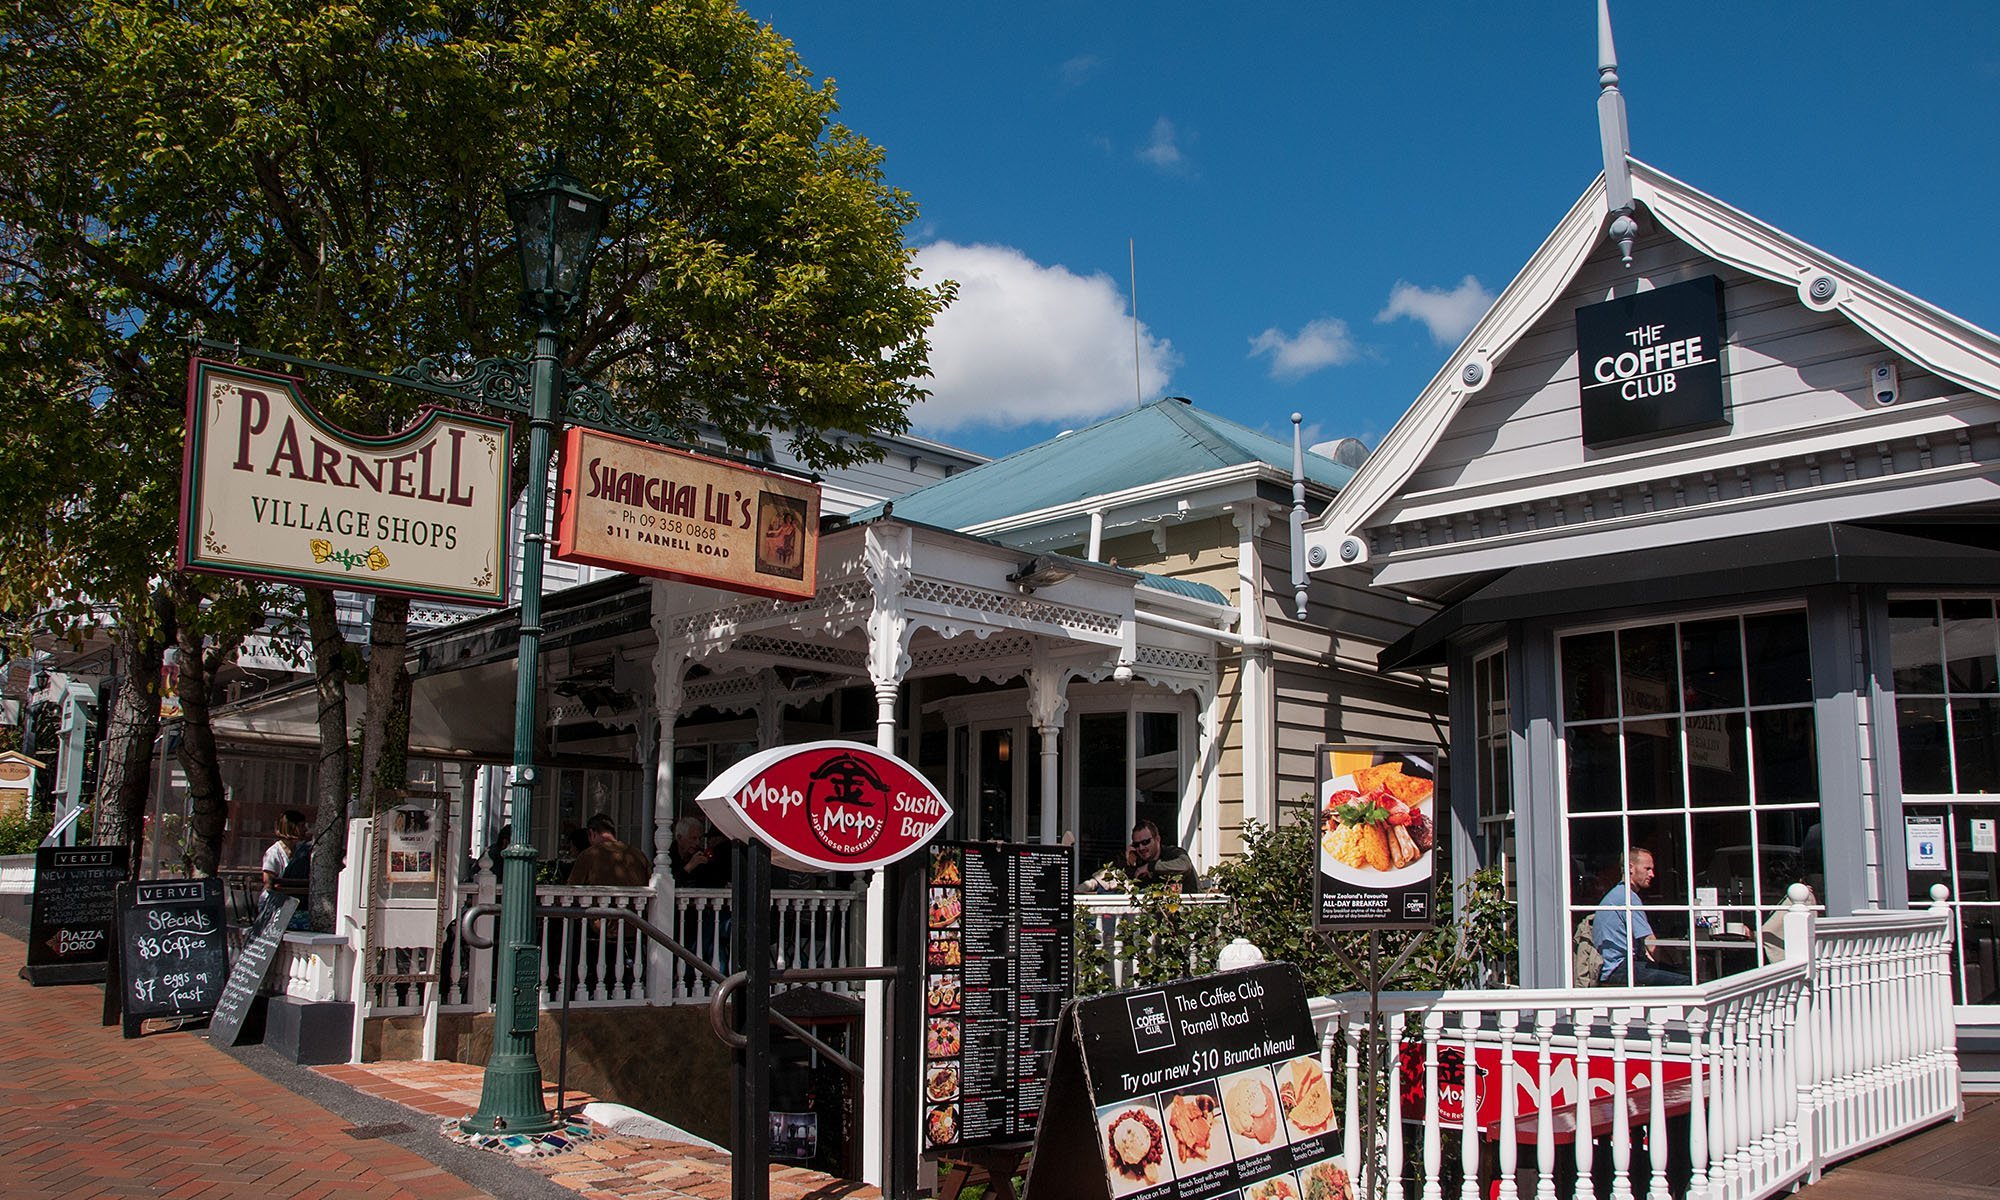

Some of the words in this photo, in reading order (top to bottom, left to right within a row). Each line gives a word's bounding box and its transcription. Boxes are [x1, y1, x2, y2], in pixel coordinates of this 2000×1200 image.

[1625, 324, 1665, 347] THE
[1594, 336, 1703, 382] COFFEE
[1621, 373, 1677, 401] CLUB
[233, 387, 474, 507] PARNELL
[587, 458, 697, 519] SHANGHAI
[704, 483, 751, 530] LIL'S
[251, 495, 370, 538] VILLAGE
[377, 515, 457, 550] SHOPS
[623, 510, 636, 525] Ph
[640, 514, 656, 528] 09
[660, 518, 682, 534] 358
[686, 523, 716, 541] 0868
[607, 525, 630, 540] 311
[638, 531, 691, 552] PARNELL
[697, 543, 730, 558] ROAD
[893, 791, 940, 817] Sushi
[811, 813, 843, 852] Japanese
[843, 819, 884, 853] Restaurant
[900, 816, 934, 838] Bar
[60, 854, 107, 863] VERVE
[143, 887, 198, 899] VERVE
[60, 929, 104, 941] PIAZZA
[60, 940, 96, 953] DORO
[137, 936, 160, 960] $3
[161, 936, 207, 960] Coffee
[135, 978, 156, 1002] $7
[163, 972, 190, 988] eggs
[196, 972, 208, 984] on
[168, 986, 204, 1008] Toast
[1175, 995, 1197, 1012] The
[1199, 985, 1236, 1008] Coffee
[1238, 980, 1265, 1000] Club
[1136, 1012, 1165, 1028] COFFEE
[1145, 1024, 1161, 1035] CLUB
[1180, 1012, 1219, 1036] Parnell
[1220, 1006, 1250, 1027] Road
[1121, 1073, 1140, 1093] Try
[1141, 1069, 1163, 1087] our
[1164, 1062, 1190, 1081] new
[1191, 1048, 1219, 1076] $10
[1223, 1043, 1262, 1067] Brunch
[1263, 1035, 1296, 1059] Menu!
[1236, 1161, 1246, 1172] Egg
[1246, 1156, 1263, 1168] Benedict
[1263, 1154, 1272, 1162] with
[1238, 1168, 1255, 1179] Smoked
[1255, 1164, 1272, 1174] Salmon
[1178, 1179, 1193, 1190] French
[1193, 1175, 1205, 1185] Toast
[1205, 1173, 1214, 1182] with
[1213, 1168, 1230, 1178] Streaky
[1180, 1187, 1195, 1198] Bacon
[1195, 1184, 1204, 1194] and
[1204, 1180, 1221, 1191] Banana
[1152, 1190, 1159, 1198] on
[1158, 1186, 1171, 1196] Toast
